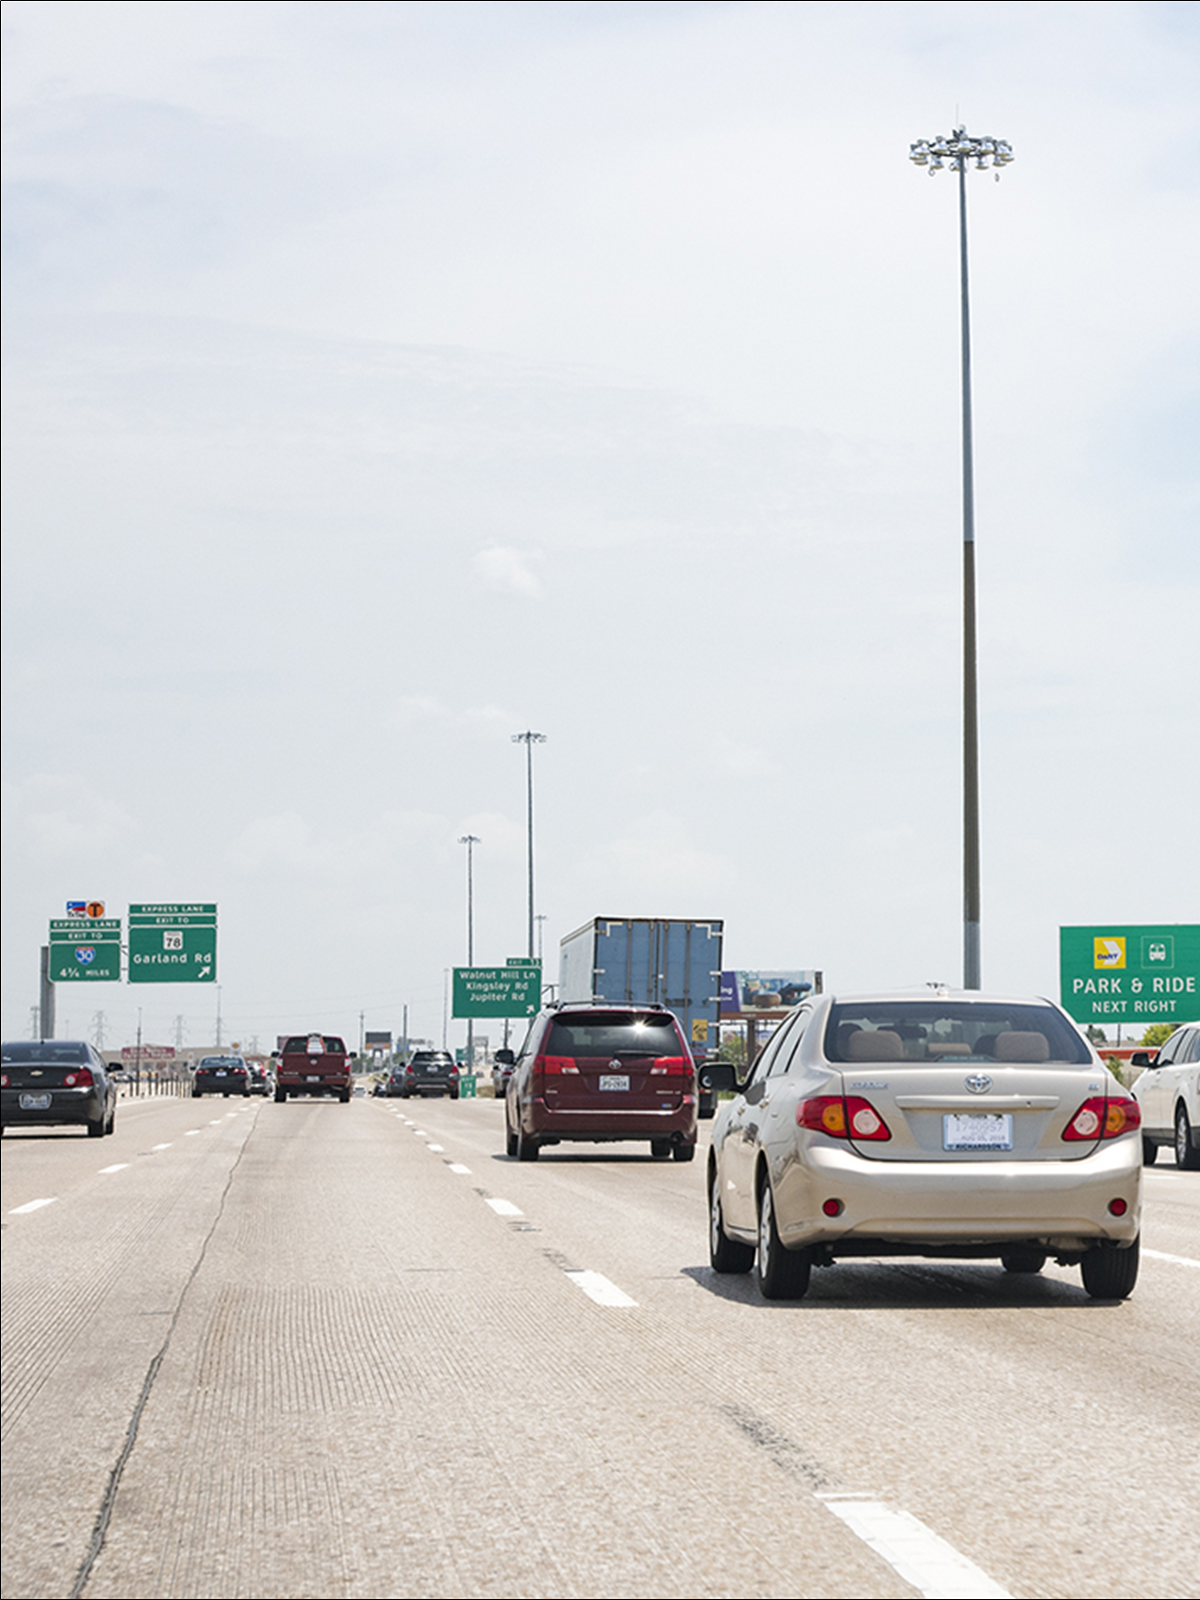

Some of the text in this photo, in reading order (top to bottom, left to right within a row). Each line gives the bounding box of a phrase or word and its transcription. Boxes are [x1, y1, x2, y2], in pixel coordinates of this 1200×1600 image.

[166, 937, 181, 948] 78
[133, 953, 212, 964] Garland Rd
[459, 970, 537, 979] Walnut Hill Ln
[466, 982, 529, 992] Kingsley Rd
[1073, 977, 1196, 994] PARK & RIDE
[470, 993, 525, 1002] Jupiter Rd
[1092, 1000, 1177, 1013] NEXT RIGHT
